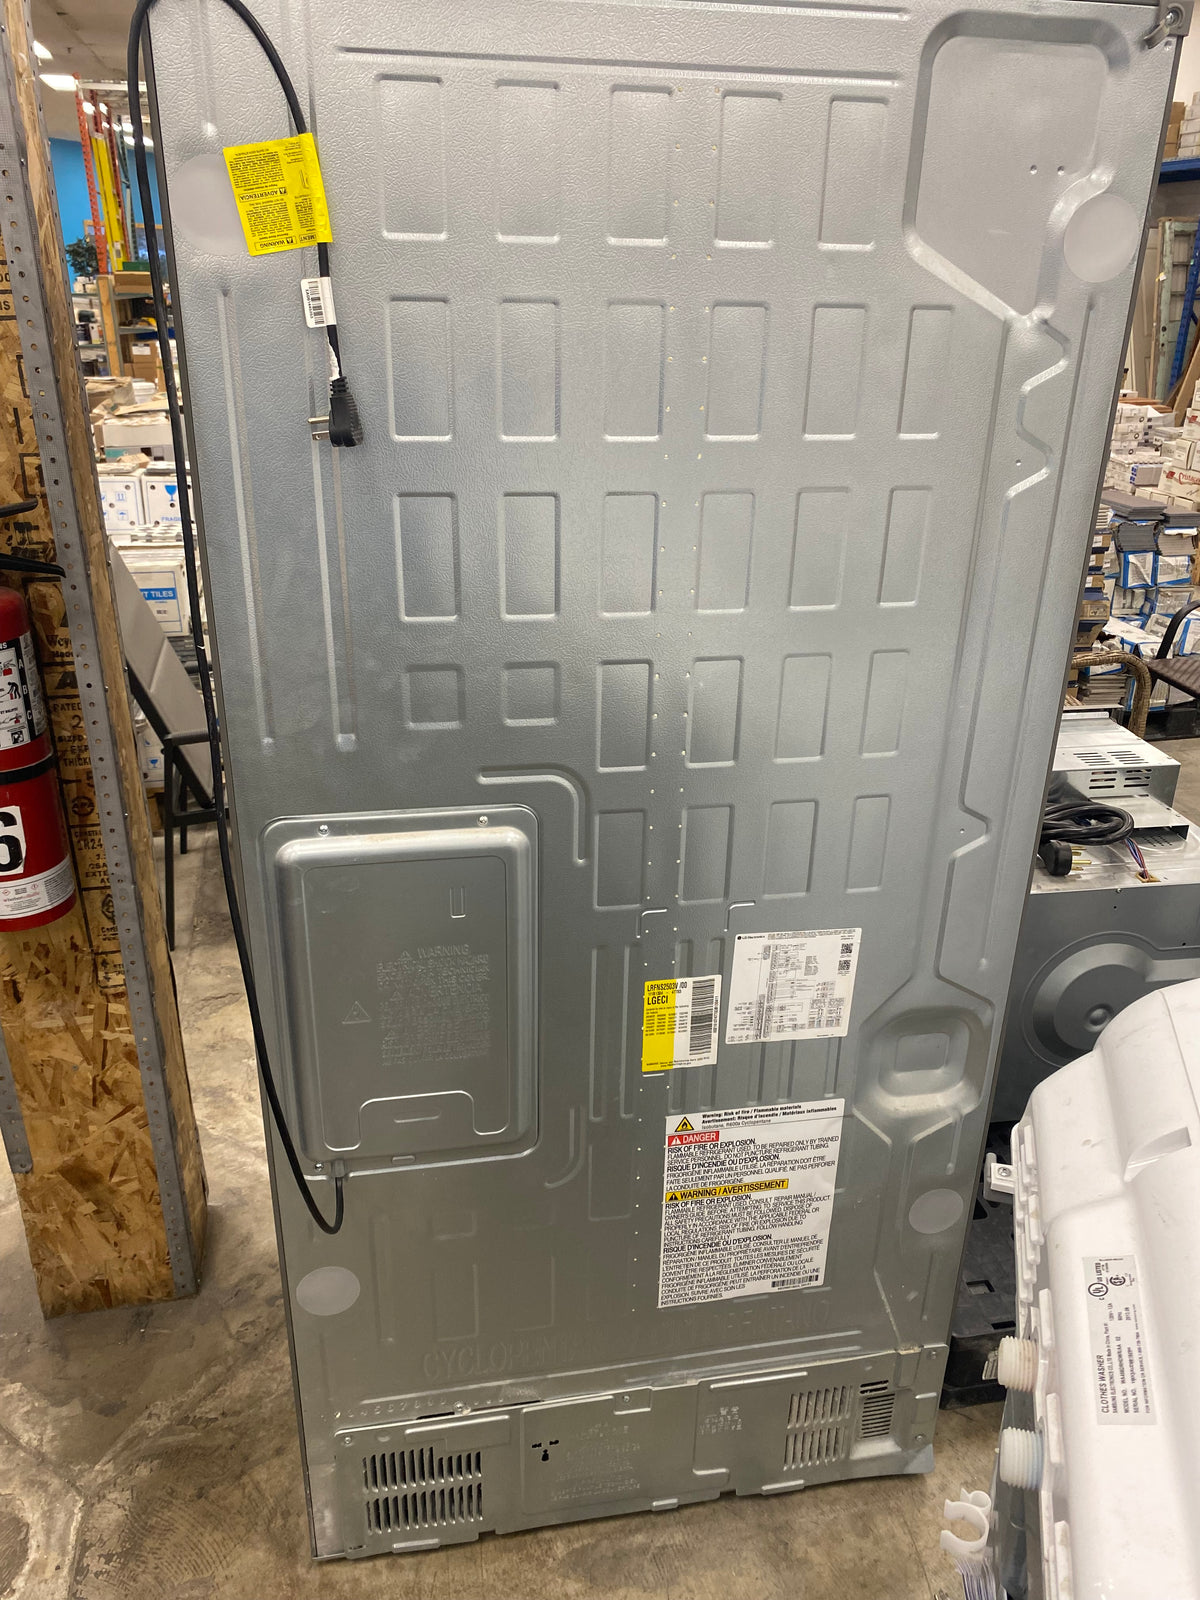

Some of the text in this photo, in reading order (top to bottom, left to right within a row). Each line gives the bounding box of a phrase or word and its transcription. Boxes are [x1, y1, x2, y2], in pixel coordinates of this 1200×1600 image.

[259, 239, 285, 248] WARNING
[150, 590, 174, 598] TILES
[682, 1131, 715, 1143] DANGER
[667, 1146, 682, 1154] RISK
[693, 1143, 707, 1151] FIRE
[666, 1163, 690, 1172] RISQUE
[680, 1188, 716, 1199] WARNING
[721, 1179, 785, 1194] AVERTISSEMENT
[663, 1245, 686, 1253] RISQUE
[1094, 1262, 1102, 1275] LISTED
[1096, 1354, 1109, 1413] CLOTHES WASHER
